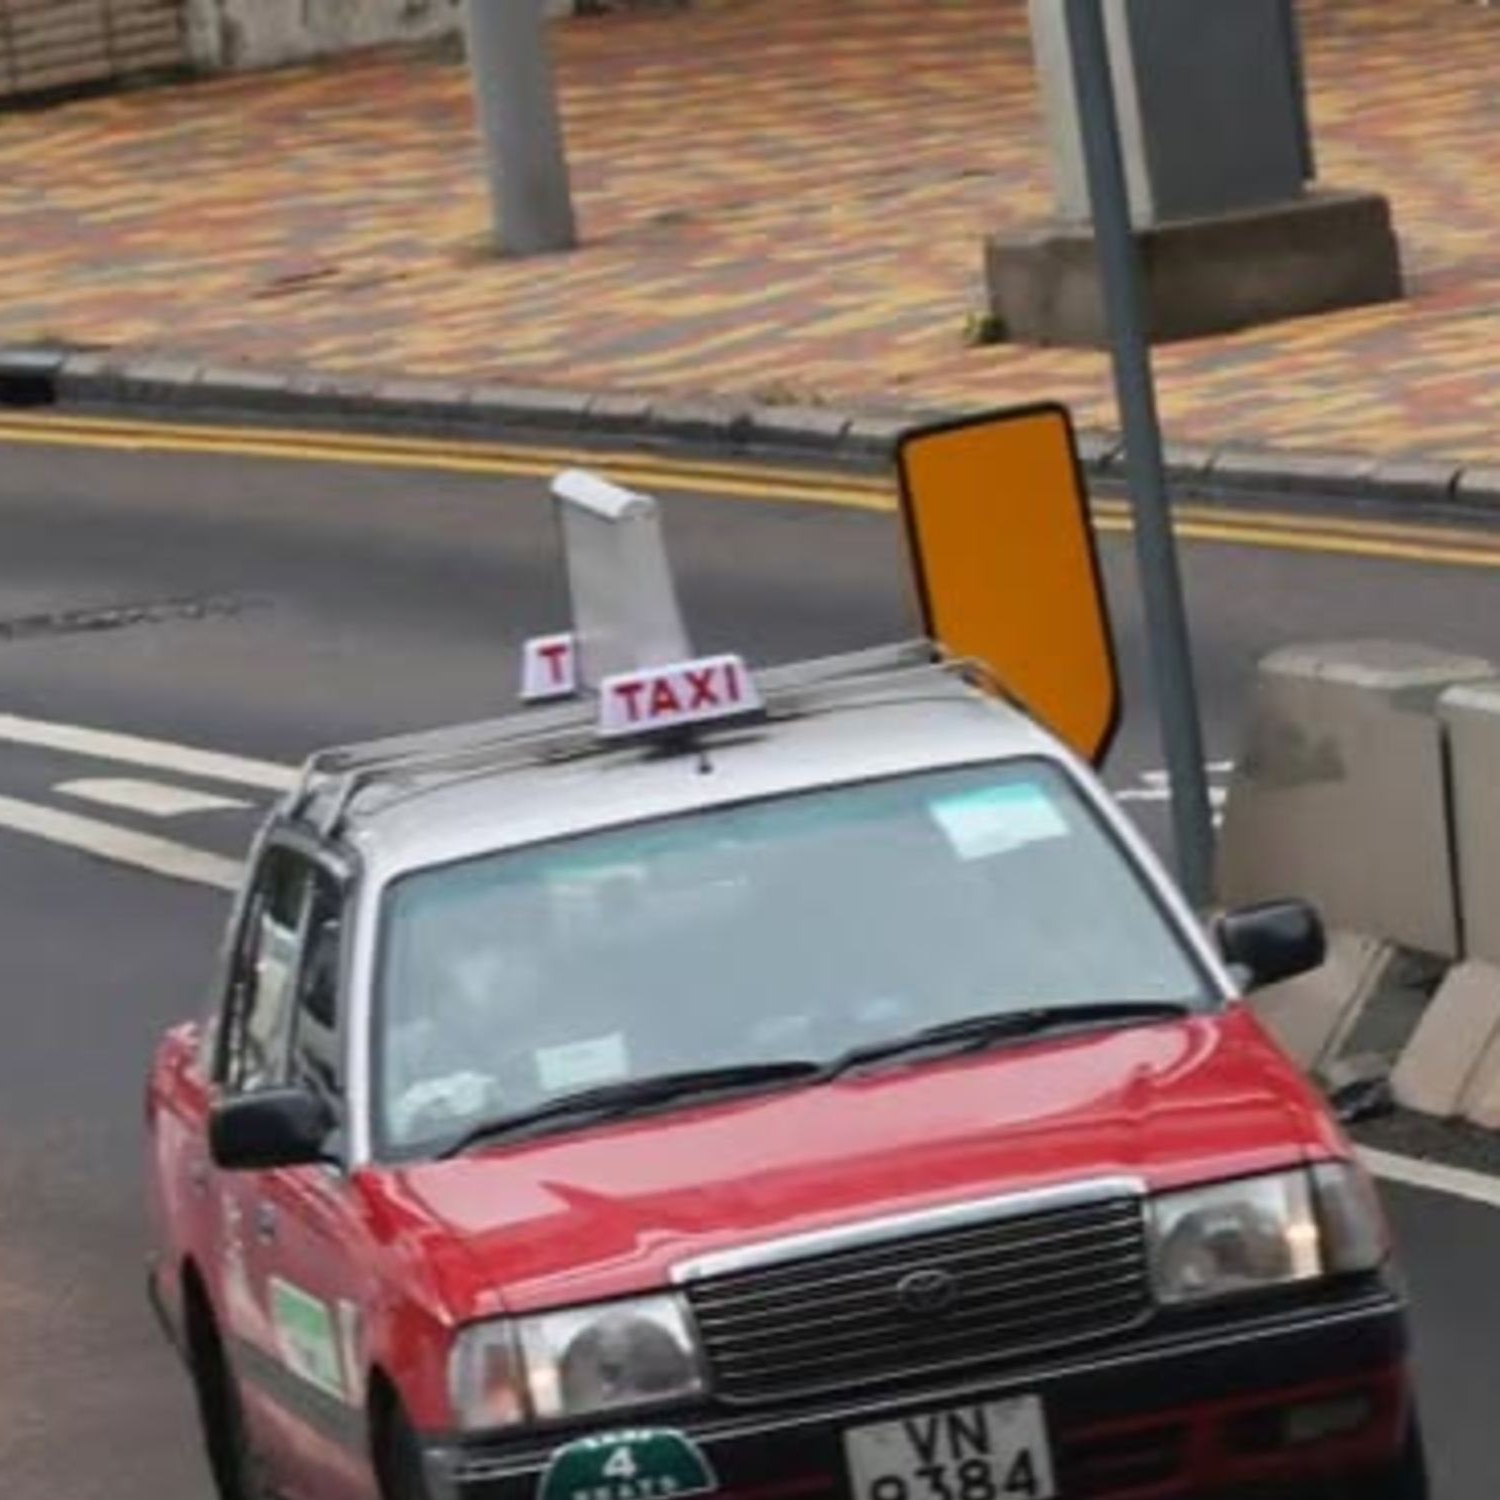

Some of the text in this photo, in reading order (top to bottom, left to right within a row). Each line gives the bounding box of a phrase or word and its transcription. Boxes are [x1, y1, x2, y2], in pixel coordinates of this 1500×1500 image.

[612, 662, 740, 722] TAXI
[602, 1446, 638, 1477] 4
[903, 1407, 989, 1464] VN
